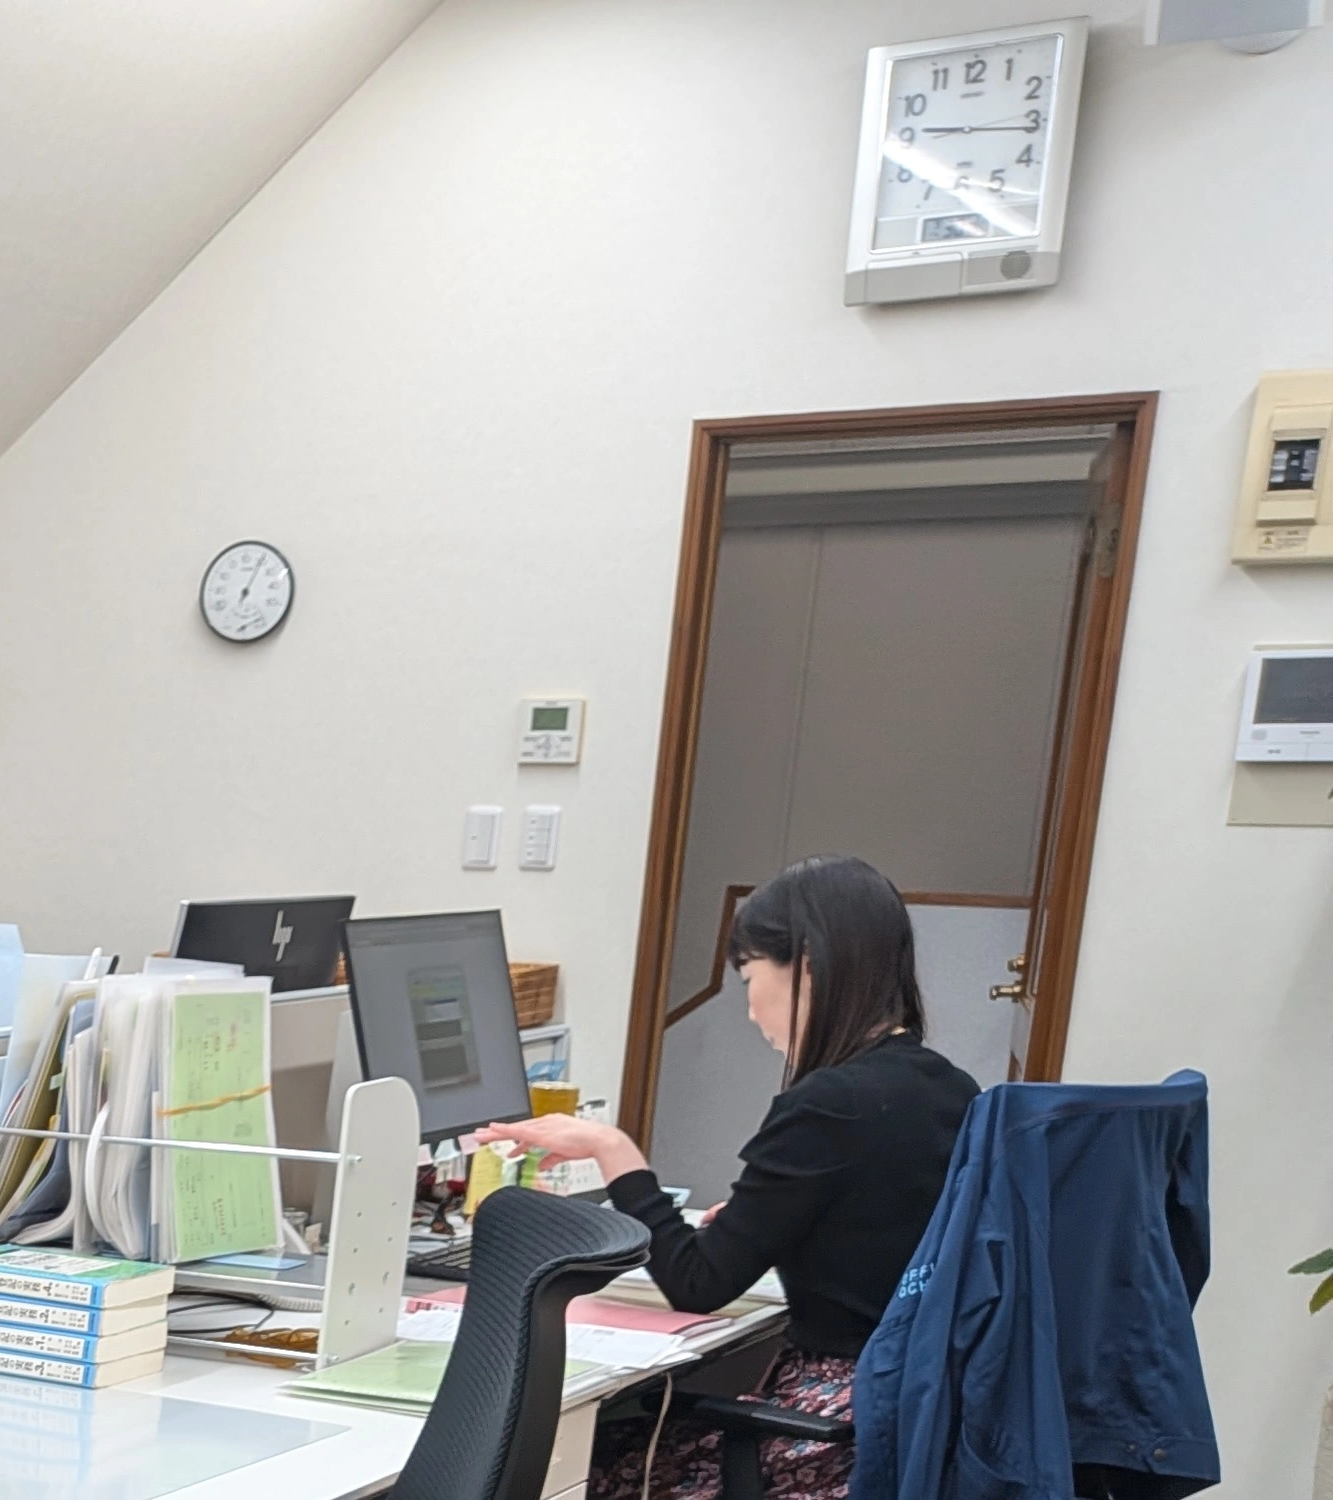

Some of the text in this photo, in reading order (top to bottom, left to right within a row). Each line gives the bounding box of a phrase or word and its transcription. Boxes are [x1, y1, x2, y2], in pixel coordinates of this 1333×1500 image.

[932, 67, 949, 91] 11
[965, 58, 987, 84] 12
[1005, 58, 1014, 82] 1
[1024, 76, 1042, 100] 2
[904, 93, 927, 118] 10
[1024, 109, 1041, 133] 3
[1015, 144, 1033, 167] 4
[988, 169, 1006, 193] 5
[272, 909, 293, 962] hp
